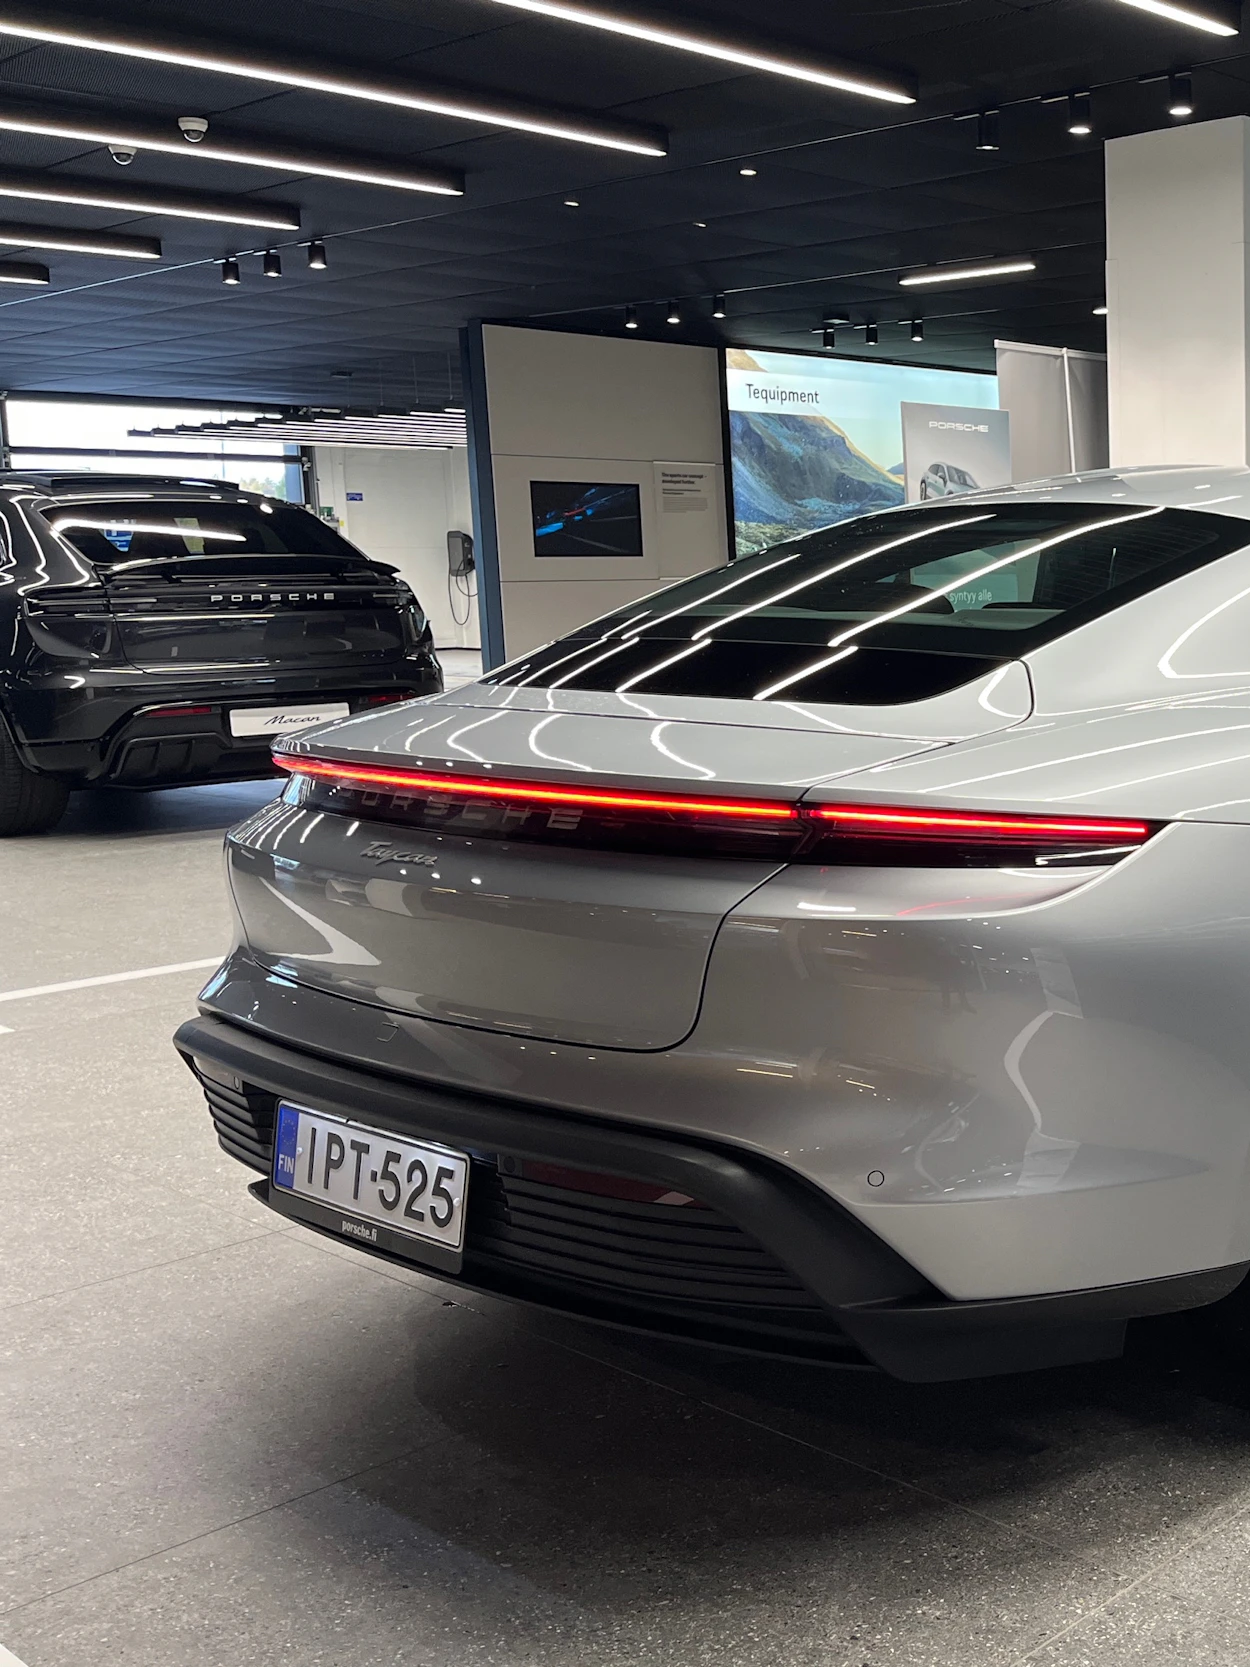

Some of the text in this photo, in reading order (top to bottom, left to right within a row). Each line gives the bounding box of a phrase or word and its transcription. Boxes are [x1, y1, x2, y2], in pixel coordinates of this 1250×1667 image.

[745, 383, 820, 404] Tequipment
[928, 420, 989, 433] PORSCHE
[210, 593, 335, 602] PORSCHE
[949, 589, 993, 605] syntyy alle
[264, 715, 322, 726] Macan
[359, 840, 439, 867] Taycan
[278, 1153, 295, 1175] FIN
[307, 1126, 456, 1229] IPT-525
[341, 1219, 378, 1242] porsche.fi
